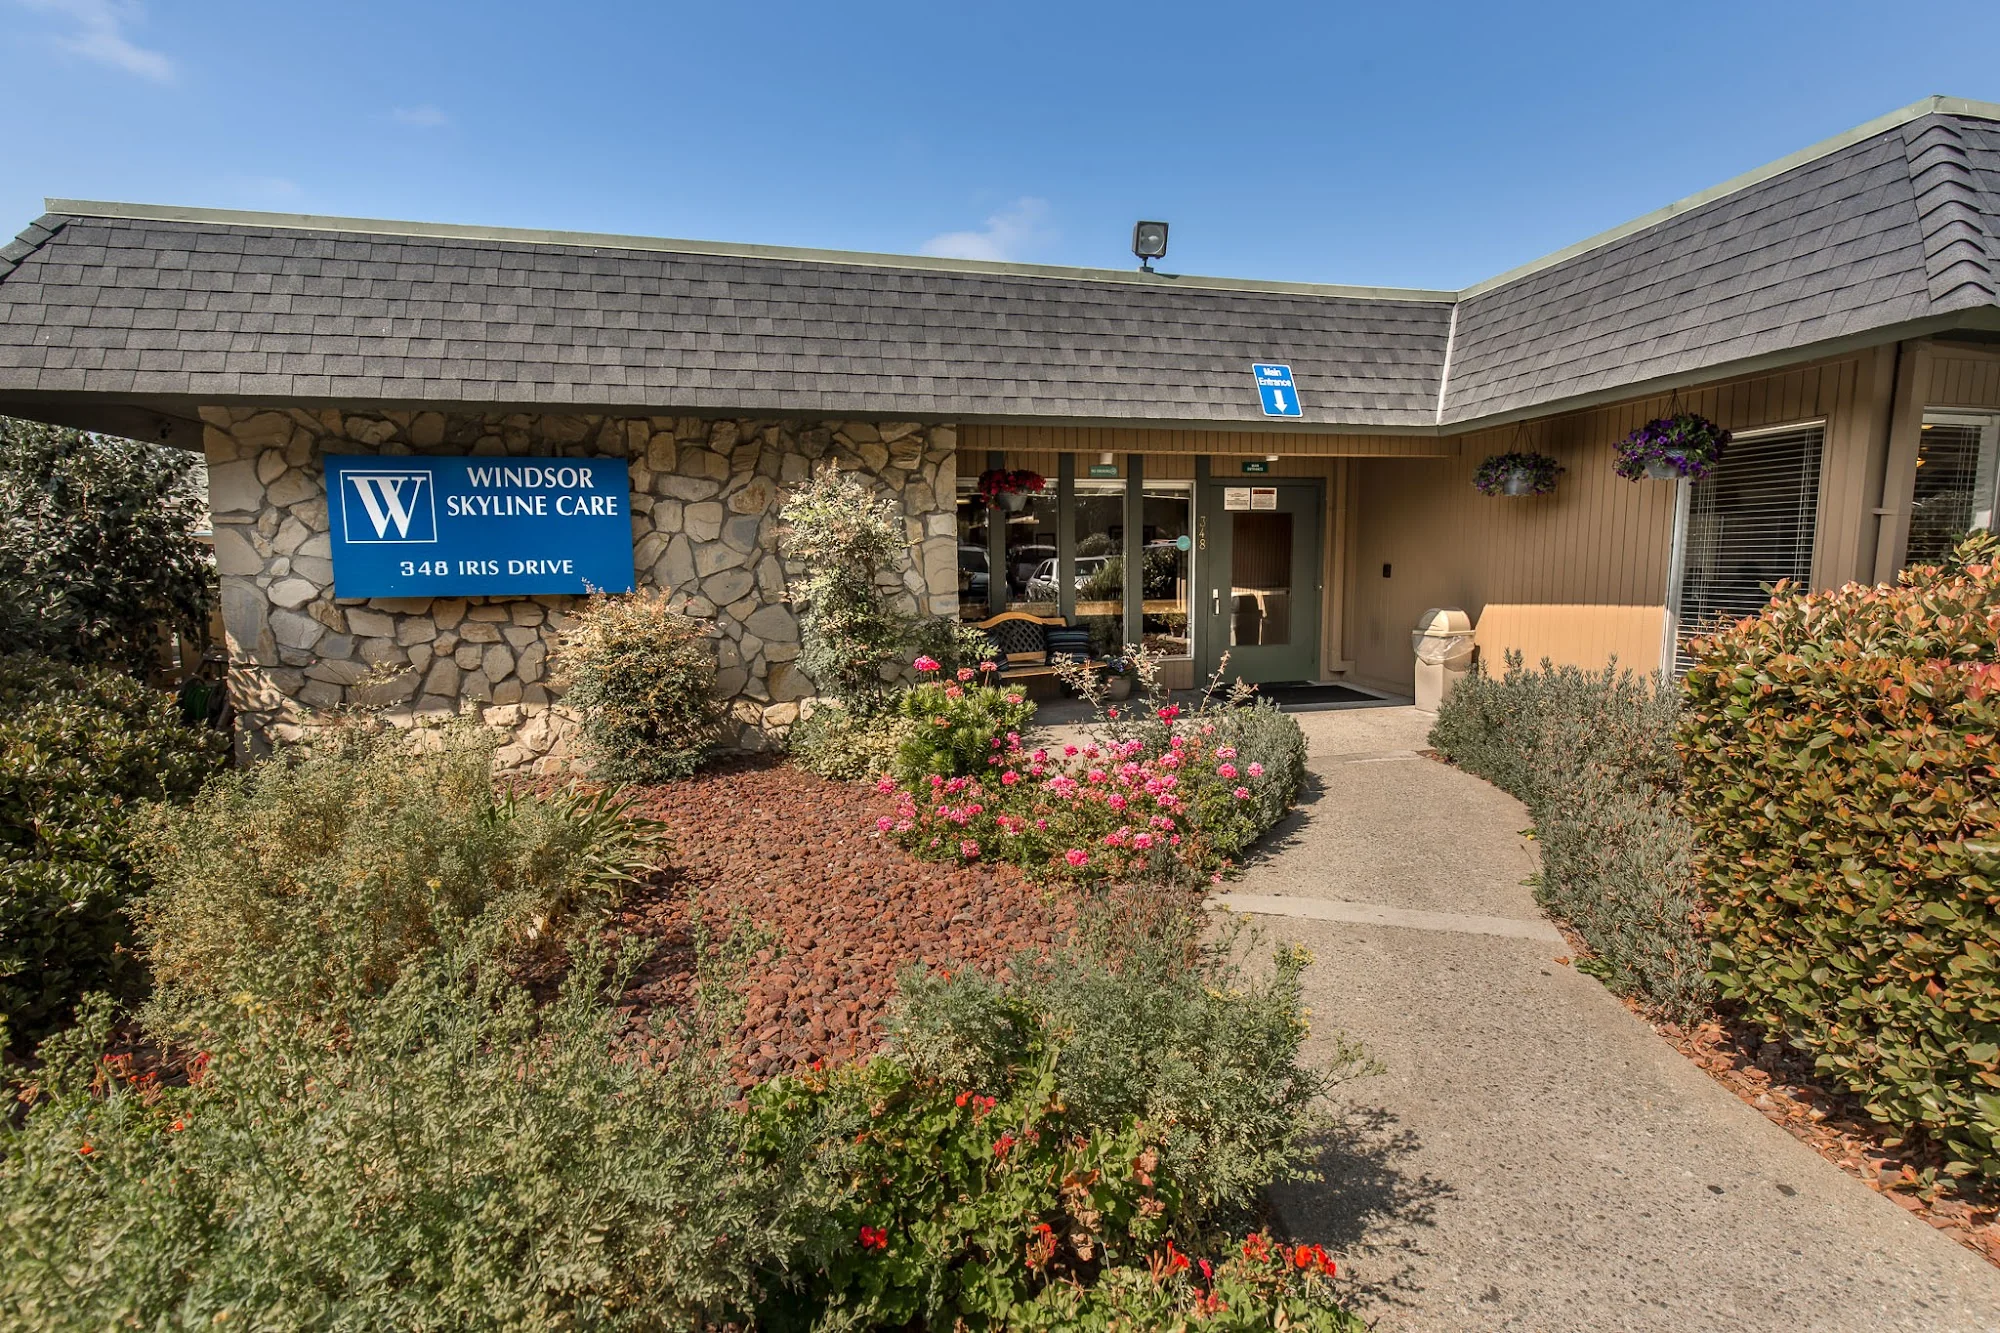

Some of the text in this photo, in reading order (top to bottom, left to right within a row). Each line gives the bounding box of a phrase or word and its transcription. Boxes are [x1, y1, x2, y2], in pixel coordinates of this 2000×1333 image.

[1258, 377, 1292, 387] Entrance
[1263, 367, 1282, 377] Main
[466, 466, 594, 489] WINDSOR
[347, 476, 427, 539] W
[447, 494, 618, 517] SKYLINE CARE
[400, 559, 574, 576] 348 IRIS DRIVE
